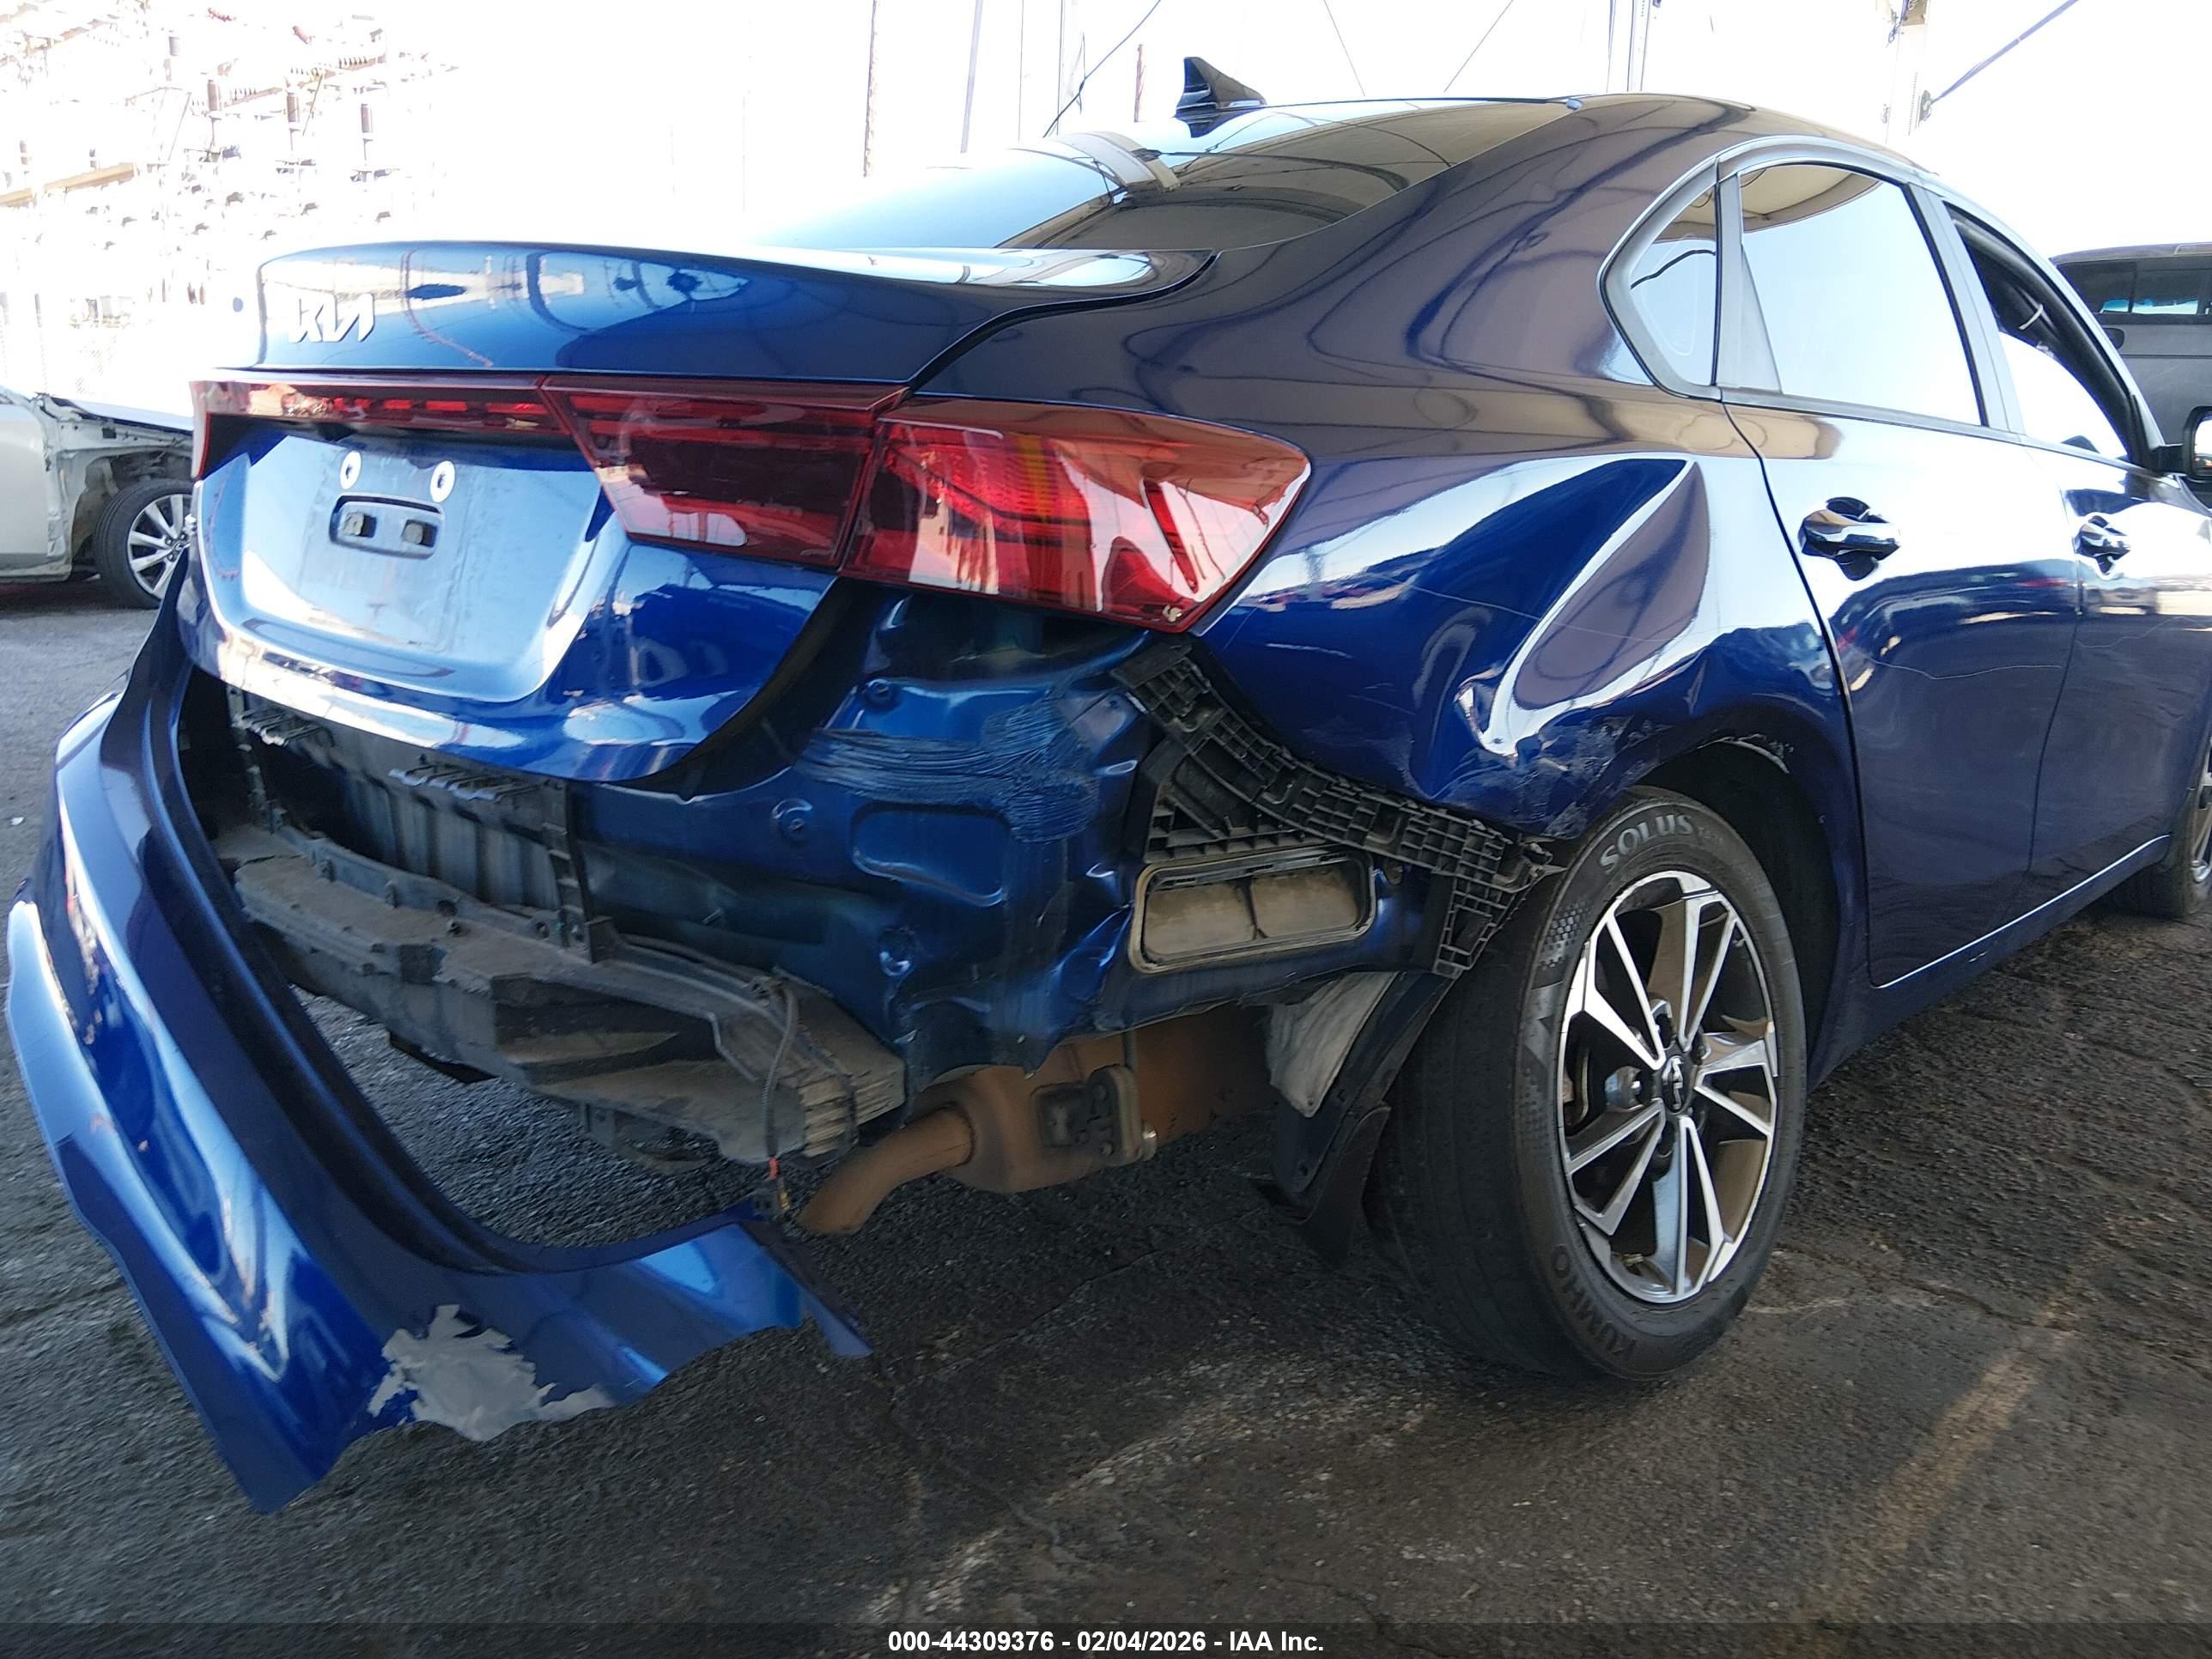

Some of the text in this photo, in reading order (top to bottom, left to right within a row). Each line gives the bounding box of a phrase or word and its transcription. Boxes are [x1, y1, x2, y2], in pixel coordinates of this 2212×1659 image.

[288, 292, 375, 343] KIA
[1599, 814, 1694, 875] SOLUS
[1551, 1243, 1638, 1354] KUMHO
